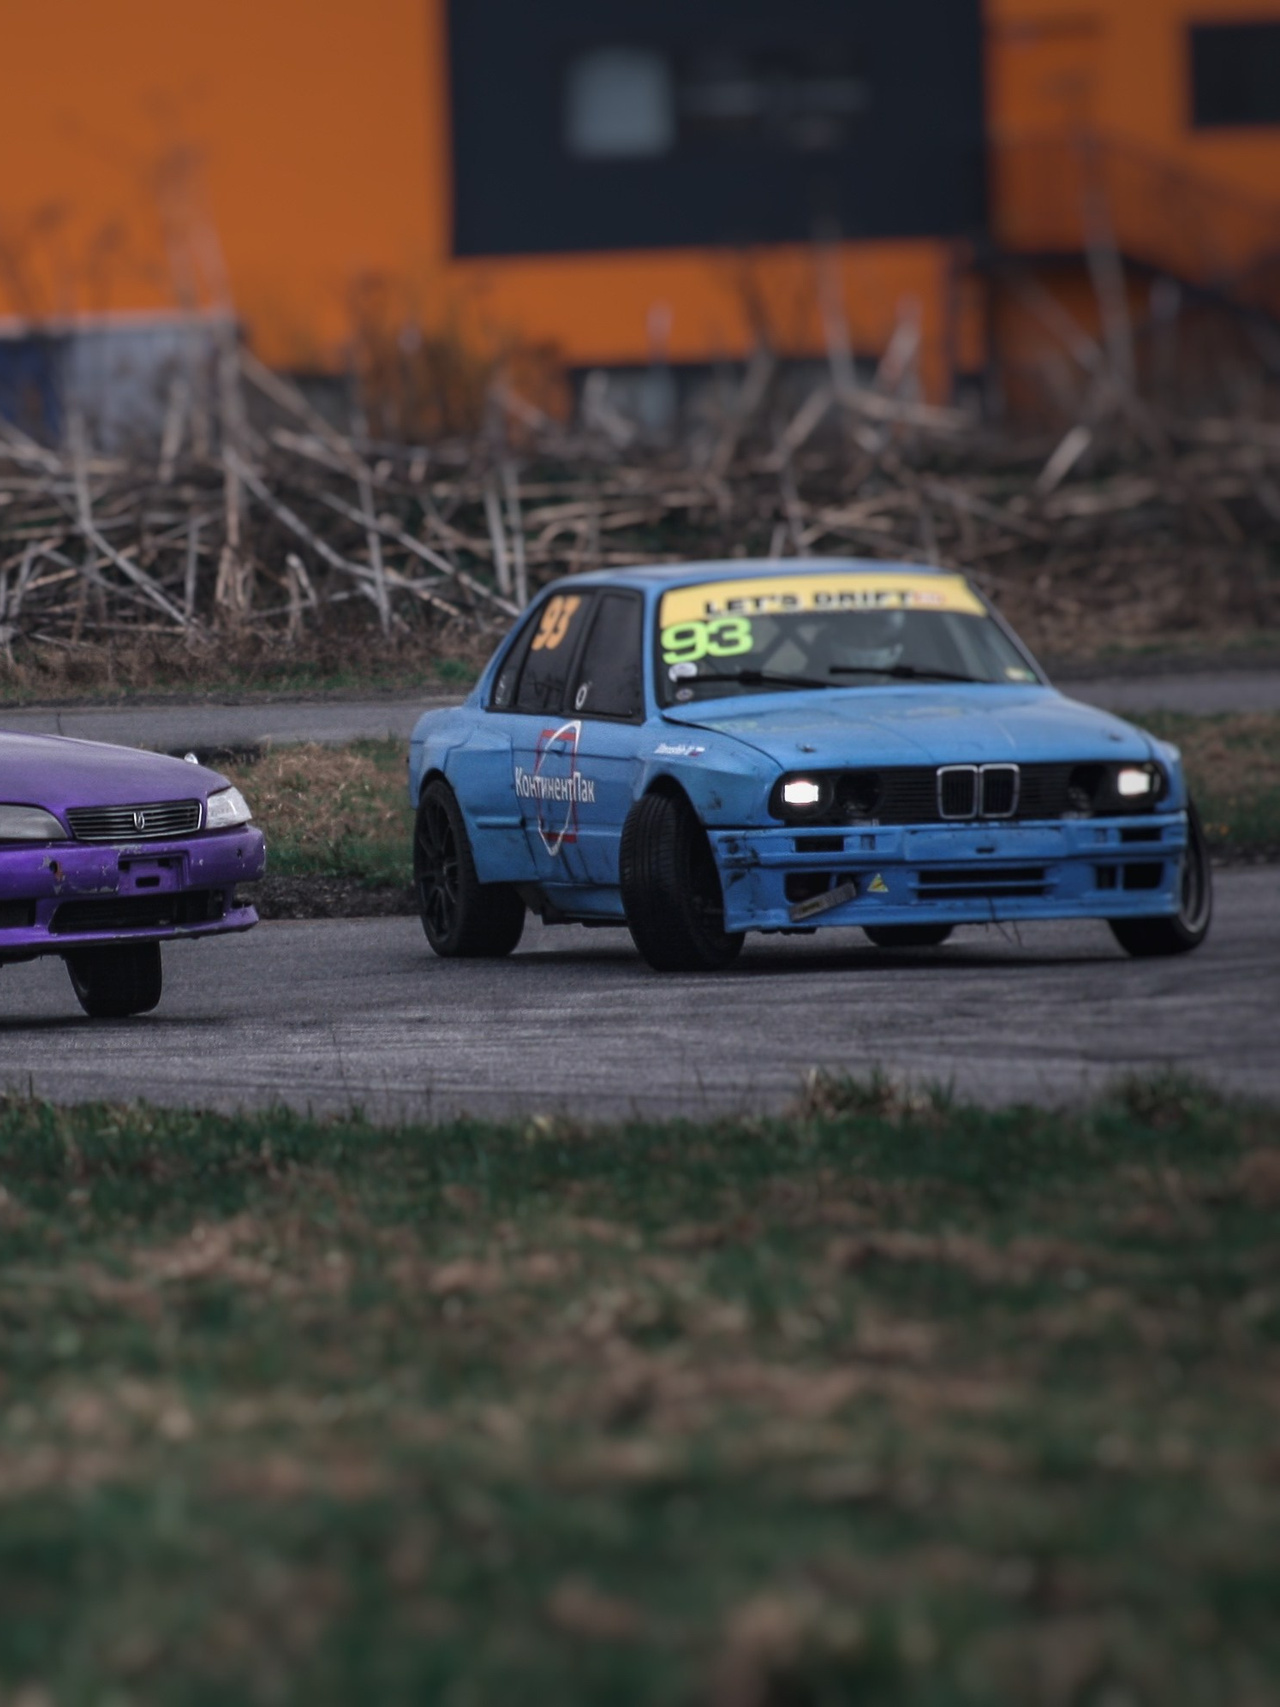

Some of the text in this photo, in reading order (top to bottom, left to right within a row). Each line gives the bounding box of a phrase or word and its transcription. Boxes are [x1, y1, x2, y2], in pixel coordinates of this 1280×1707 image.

[531, 595, 581, 651] 93
[705, 595, 801, 619] LET'S
[814, 590, 911, 610] DRIFT
[660, 617, 754, 665] 93
[515, 766, 595, 803] КонтинентПак
